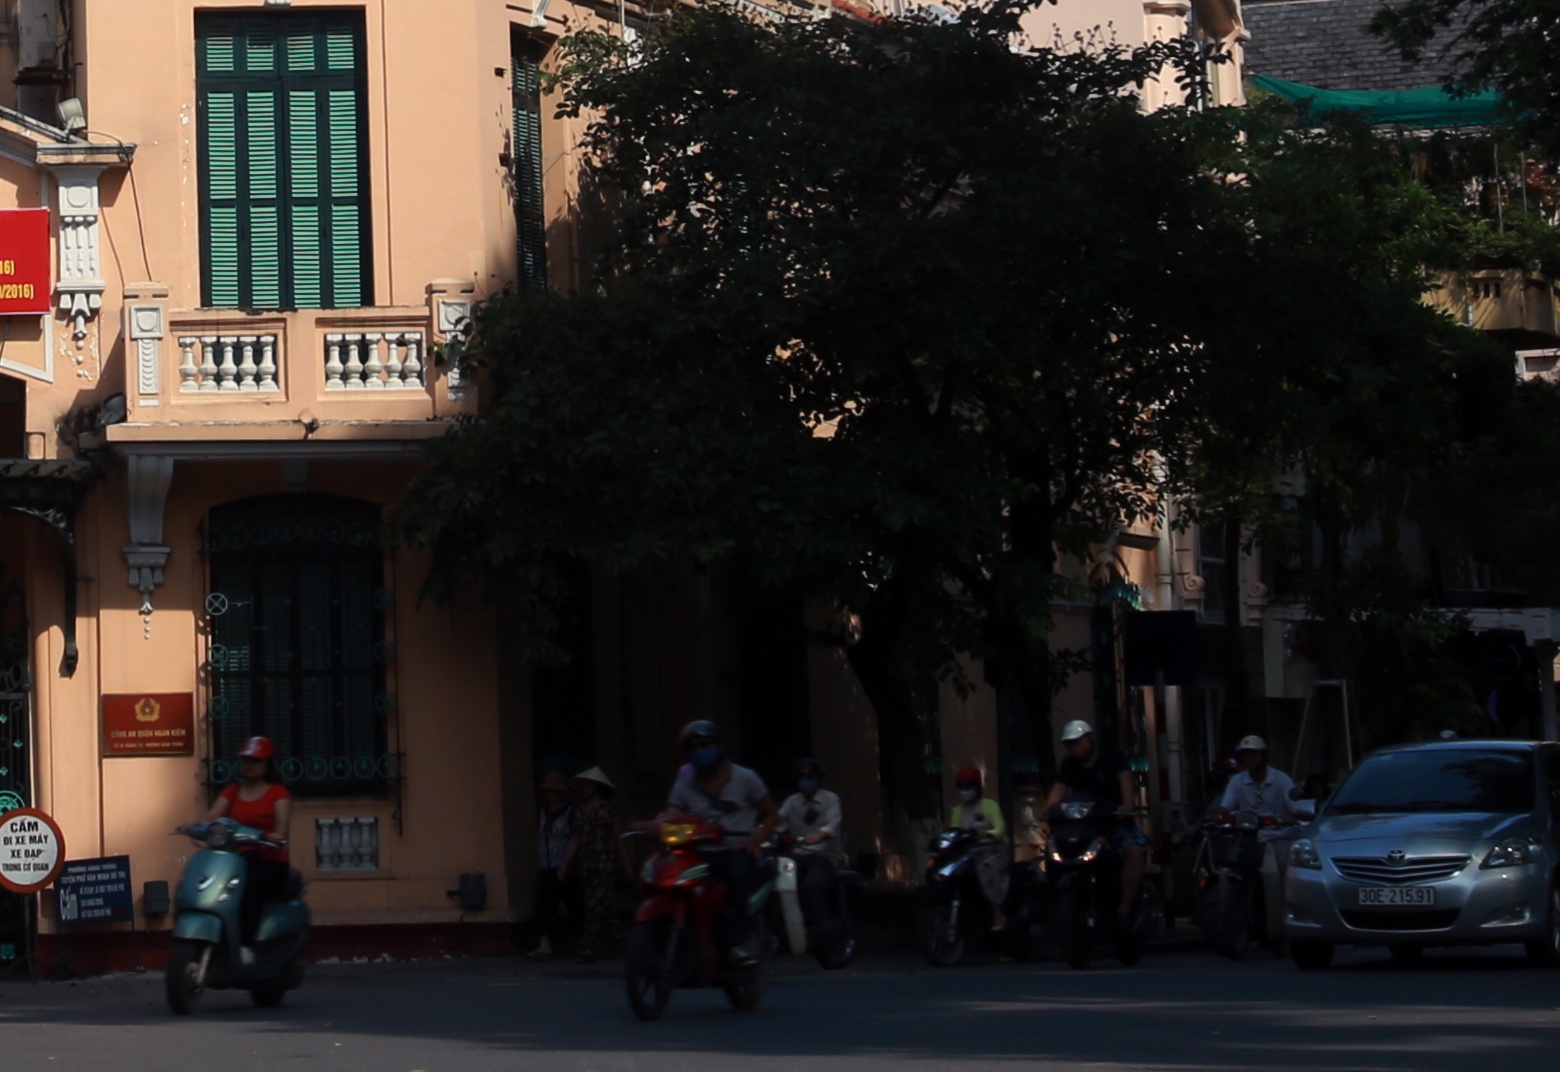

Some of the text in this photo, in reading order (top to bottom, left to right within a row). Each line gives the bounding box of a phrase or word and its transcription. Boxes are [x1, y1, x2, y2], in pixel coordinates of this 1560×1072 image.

[10, 818, 39, 833] CẤM
[3, 833, 49, 845] ĐI XE MÁY
[10, 849, 43, 860] XE ĐẠP
[2, 863, 21, 871] TRONG
[32, 863, 49, 872] QUAN
